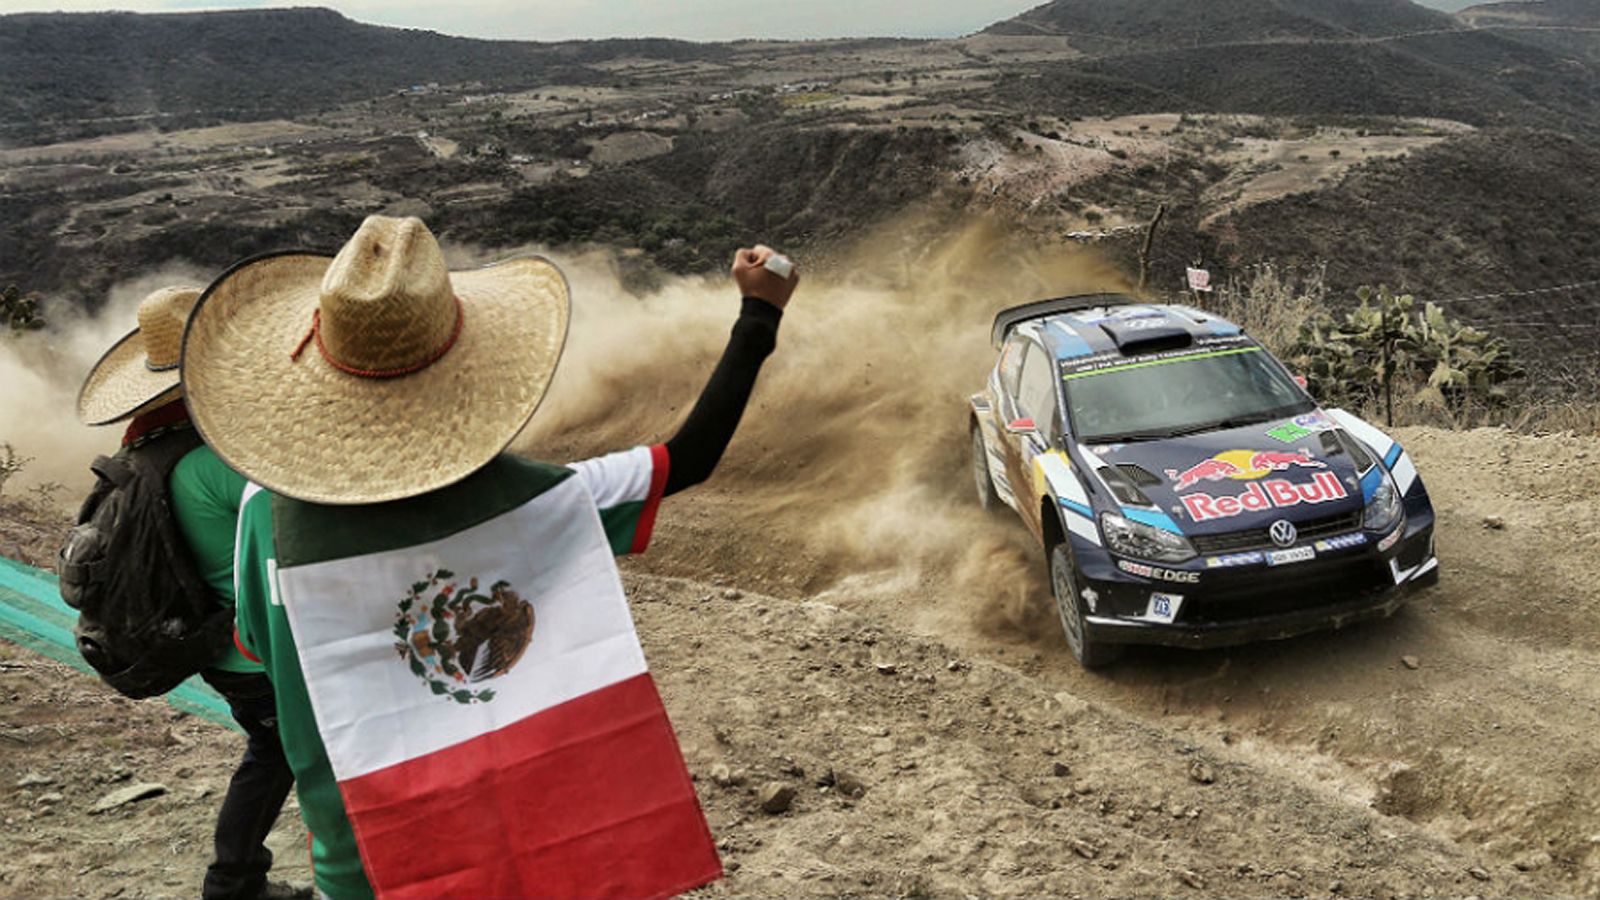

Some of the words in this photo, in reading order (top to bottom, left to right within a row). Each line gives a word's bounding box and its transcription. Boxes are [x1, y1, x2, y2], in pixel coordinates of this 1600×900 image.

[1180, 481, 1272, 522] Red
[1262, 470, 1349, 508] Bull
[1151, 568, 1201, 583] EDGE
